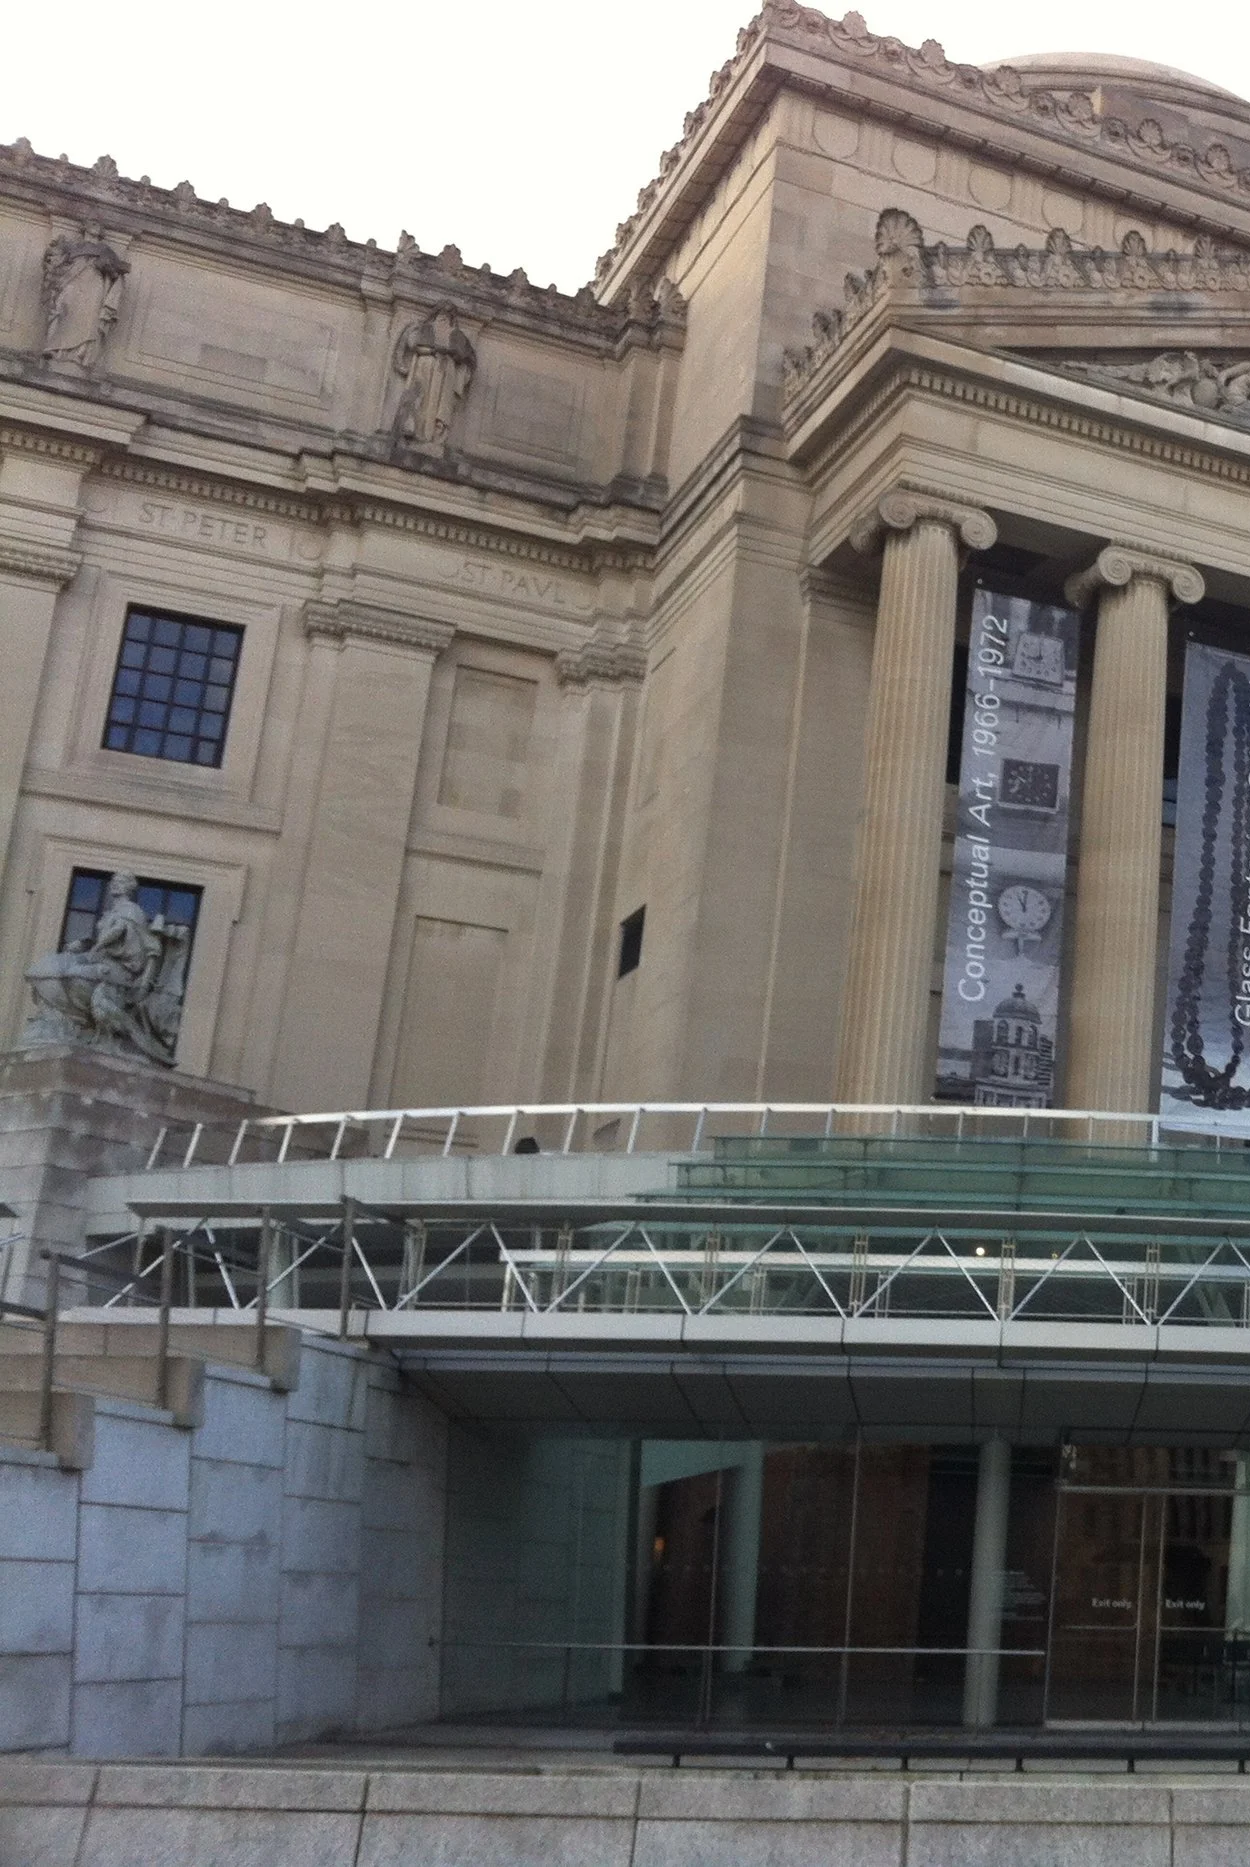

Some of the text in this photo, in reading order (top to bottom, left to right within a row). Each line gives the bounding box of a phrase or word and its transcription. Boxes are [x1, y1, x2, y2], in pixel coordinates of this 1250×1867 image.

[180, 510, 269, 549] PETER
[958, 614, 1008, 1001] Conceptual Art, 1966-1972
[1111, 1599, 1132, 1610] only
[1165, 1599, 1206, 1611] Exit only
